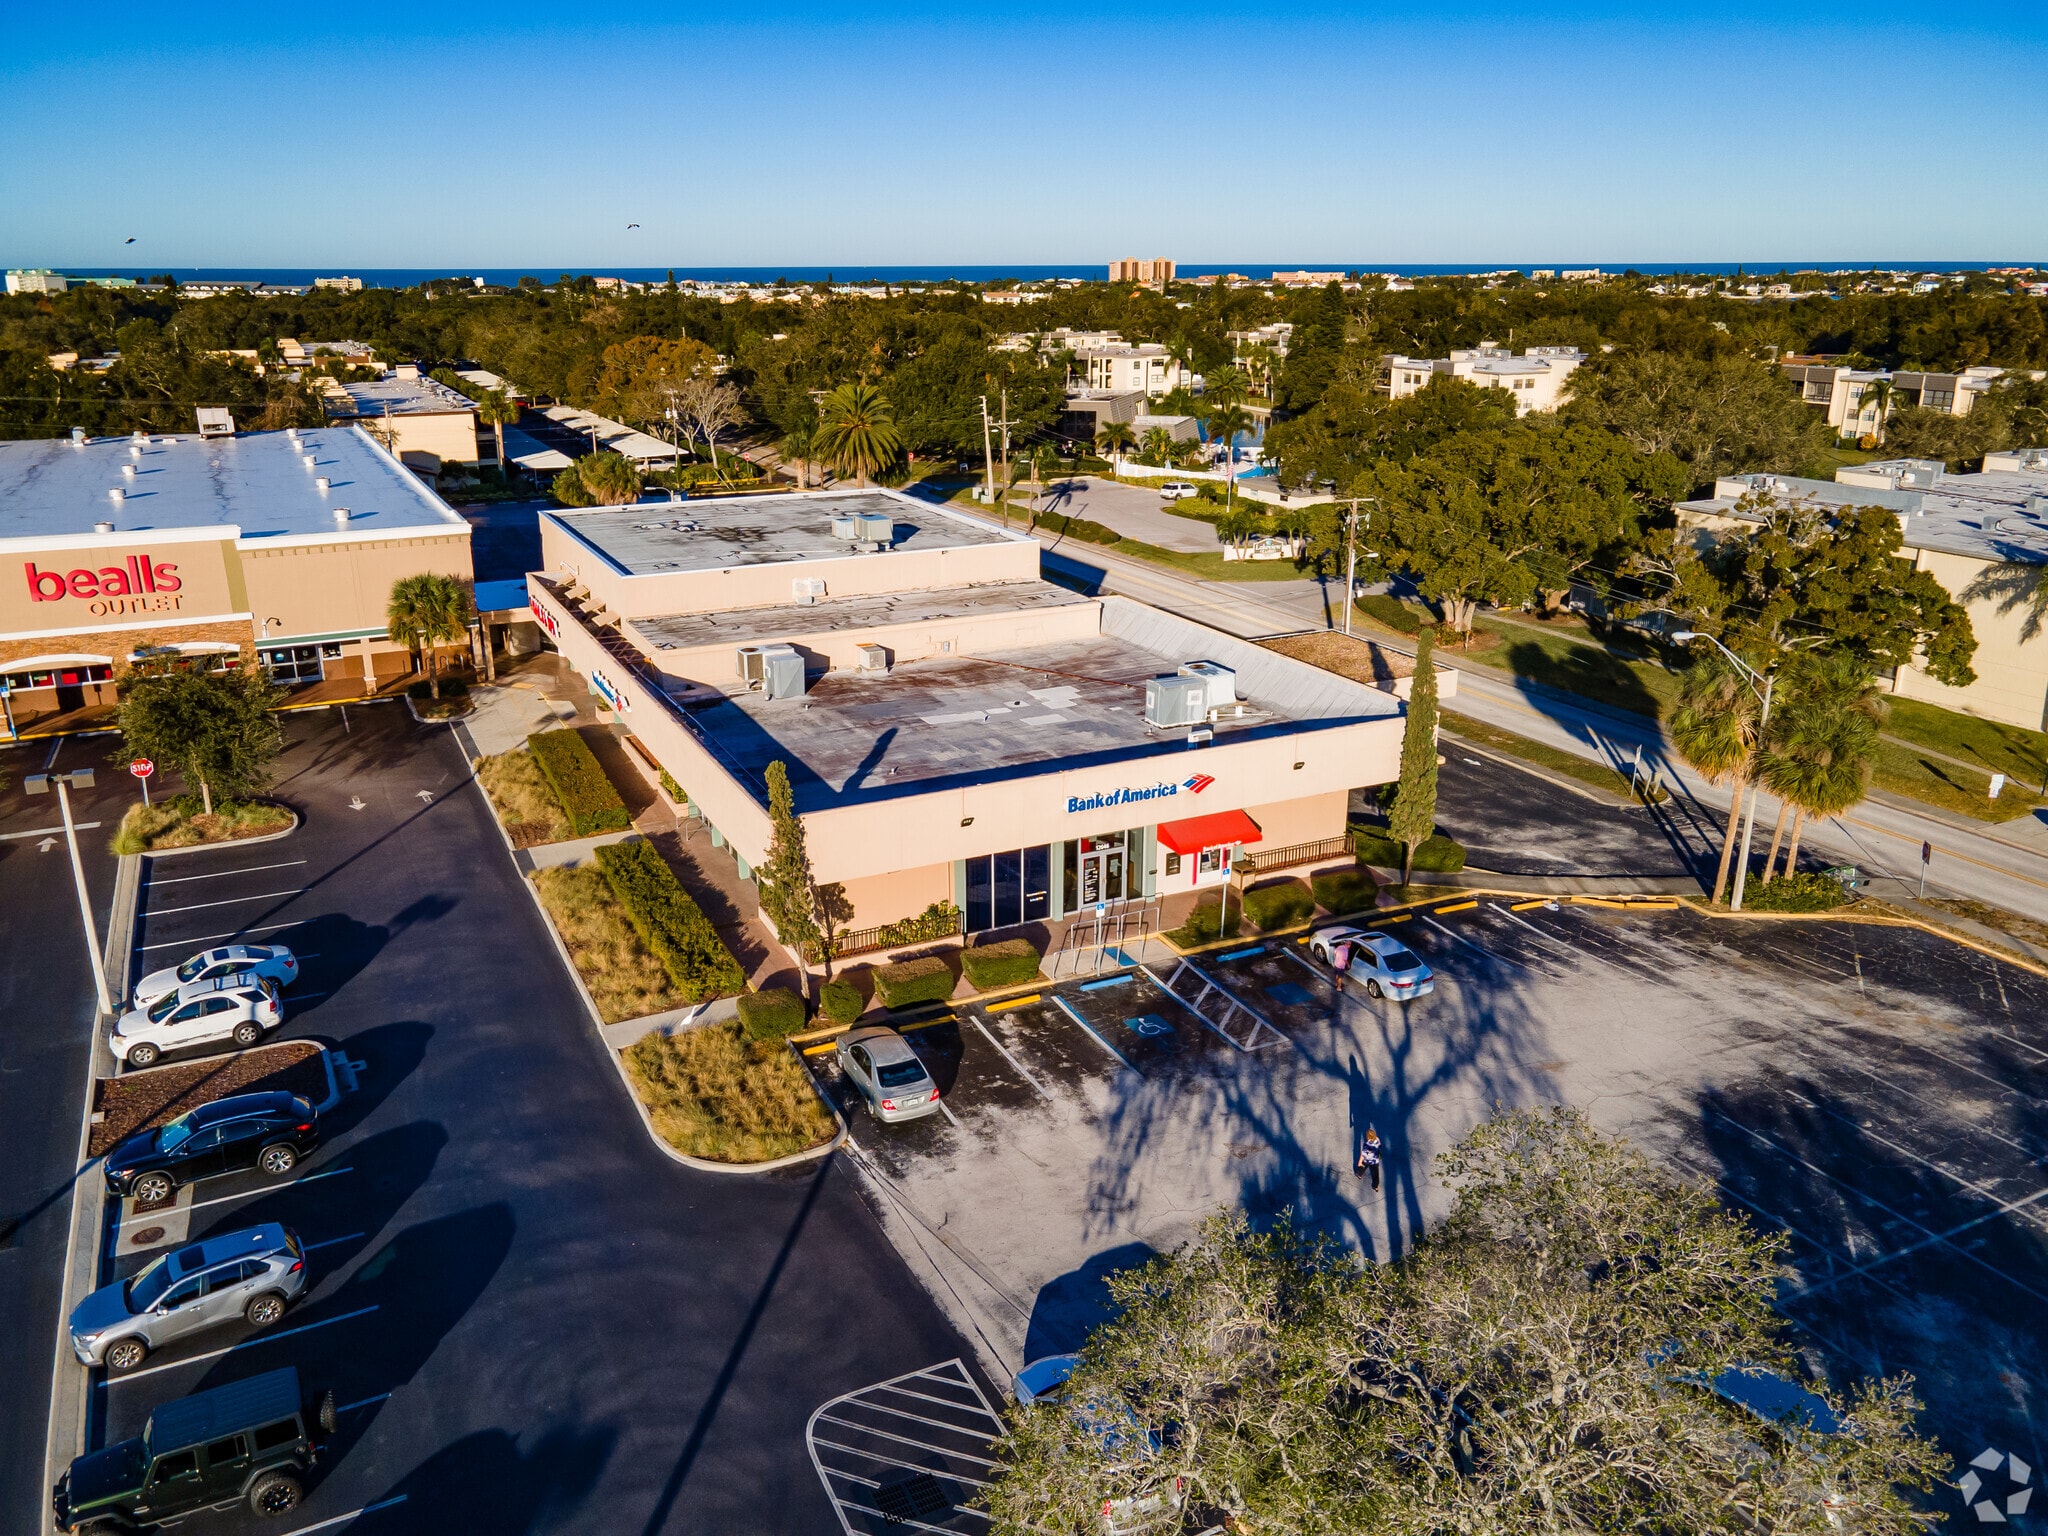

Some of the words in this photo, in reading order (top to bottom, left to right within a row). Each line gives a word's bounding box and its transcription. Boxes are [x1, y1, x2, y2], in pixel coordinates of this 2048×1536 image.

[24, 554, 182, 602] bealls
[89, 595, 183, 616] OUTLET
[132, 763, 151, 772] STOP
[1067, 793, 1104, 813] Bank
[1105, 788, 1120, 806] of
[1121, 783, 1177, 804] America
